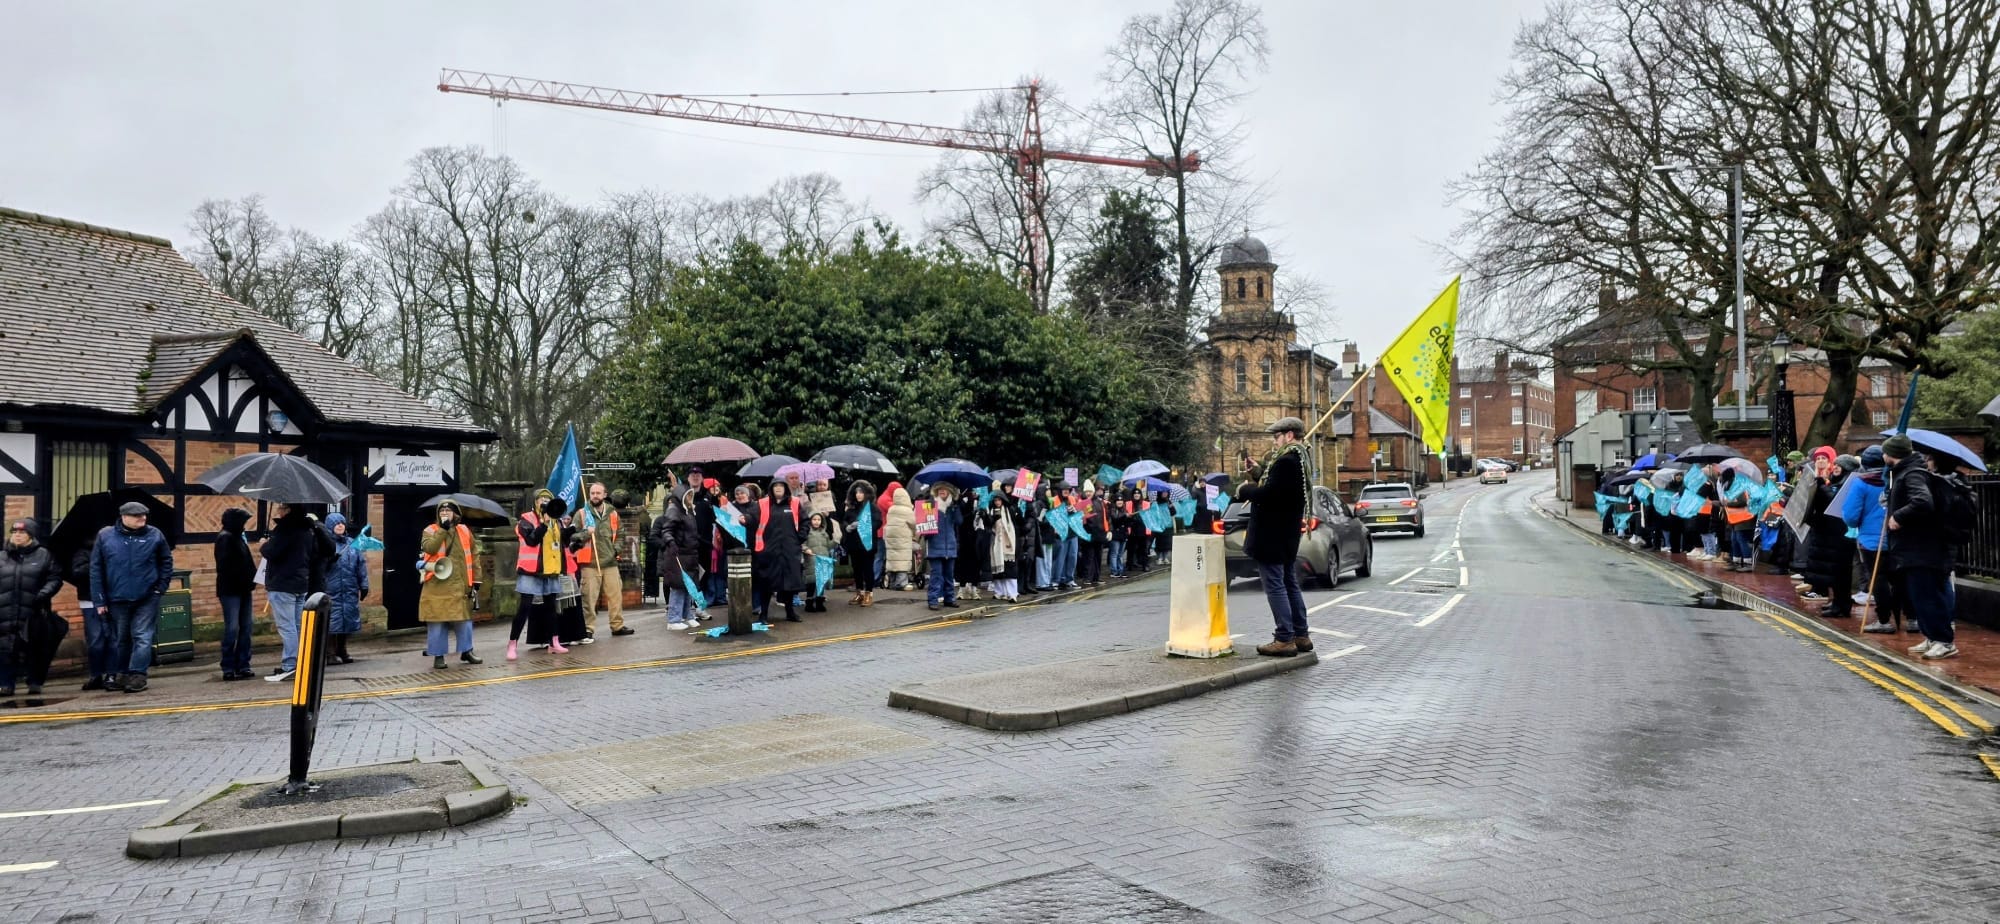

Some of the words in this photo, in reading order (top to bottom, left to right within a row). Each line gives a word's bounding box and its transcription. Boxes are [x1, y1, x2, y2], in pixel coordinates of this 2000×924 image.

[396, 461, 408, 474] The
[408, 461, 434, 479] Gardens
[916, 521, 938, 532] STRIKE
[162, 605, 184, 613] LITTER
